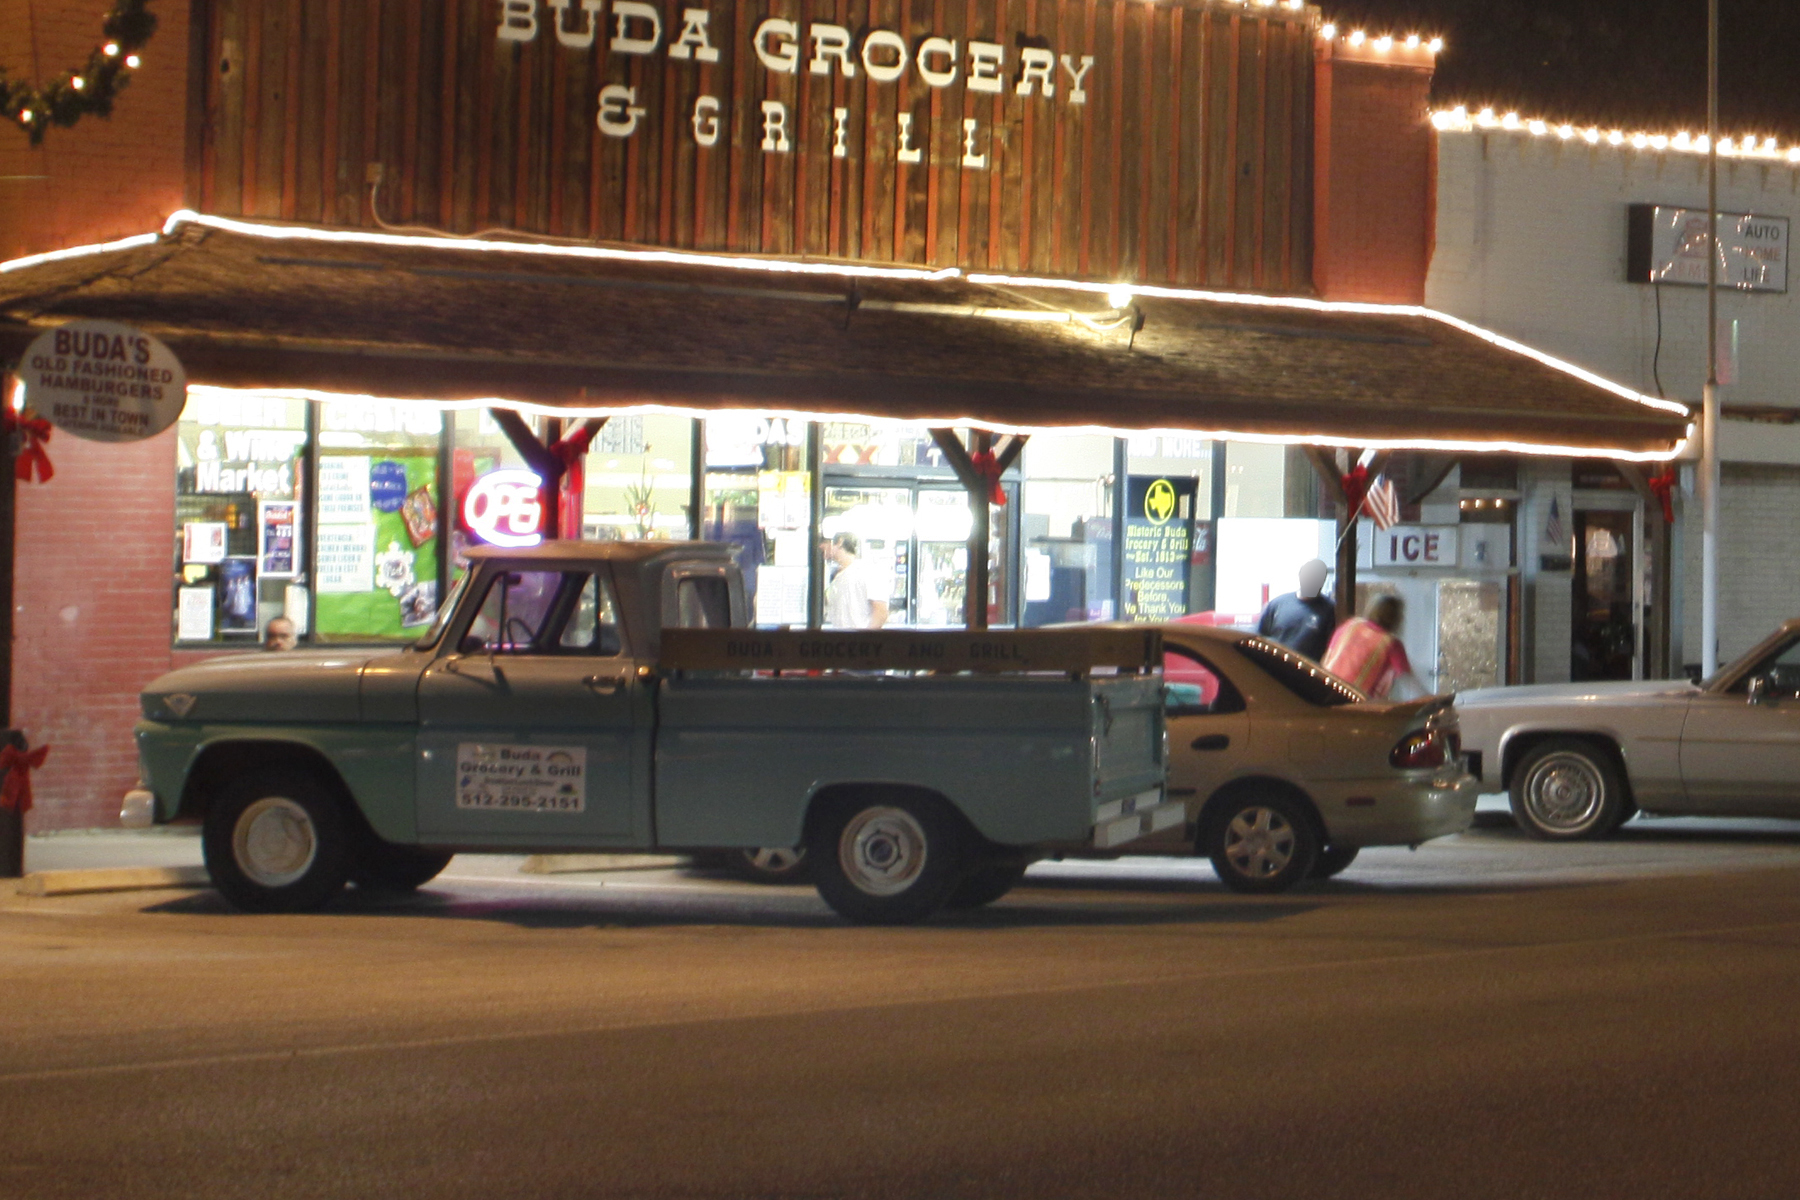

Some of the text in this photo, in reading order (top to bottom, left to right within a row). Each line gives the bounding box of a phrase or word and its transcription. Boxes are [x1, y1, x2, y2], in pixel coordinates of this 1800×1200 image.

[754, 17, 1094, 103] GROCERY
[596, 84, 986, 169] & GRILL
[1745, 223, 1780, 240] AUTO
[1745, 246, 1781, 262] HOME
[55, 329, 151, 364] BUDA'S
[31, 355, 173, 384] OLD FASHIONED
[39, 373, 164, 400] HAMBURGERS
[53, 402, 149, 427] BEST IN TOWN
[196, 461, 292, 492] Market
[1389, 533, 1439, 562] ICE
[1135, 566, 1174, 579] Like Our
[1138, 602, 1167, 614] Thank
[1169, 601, 1186, 614] You
[799, 642, 884, 659] GROCERY
[907, 643, 945, 659] AND
[500, 748, 541, 760] Buda
[460, 762, 581, 777] Grocery & Grill
